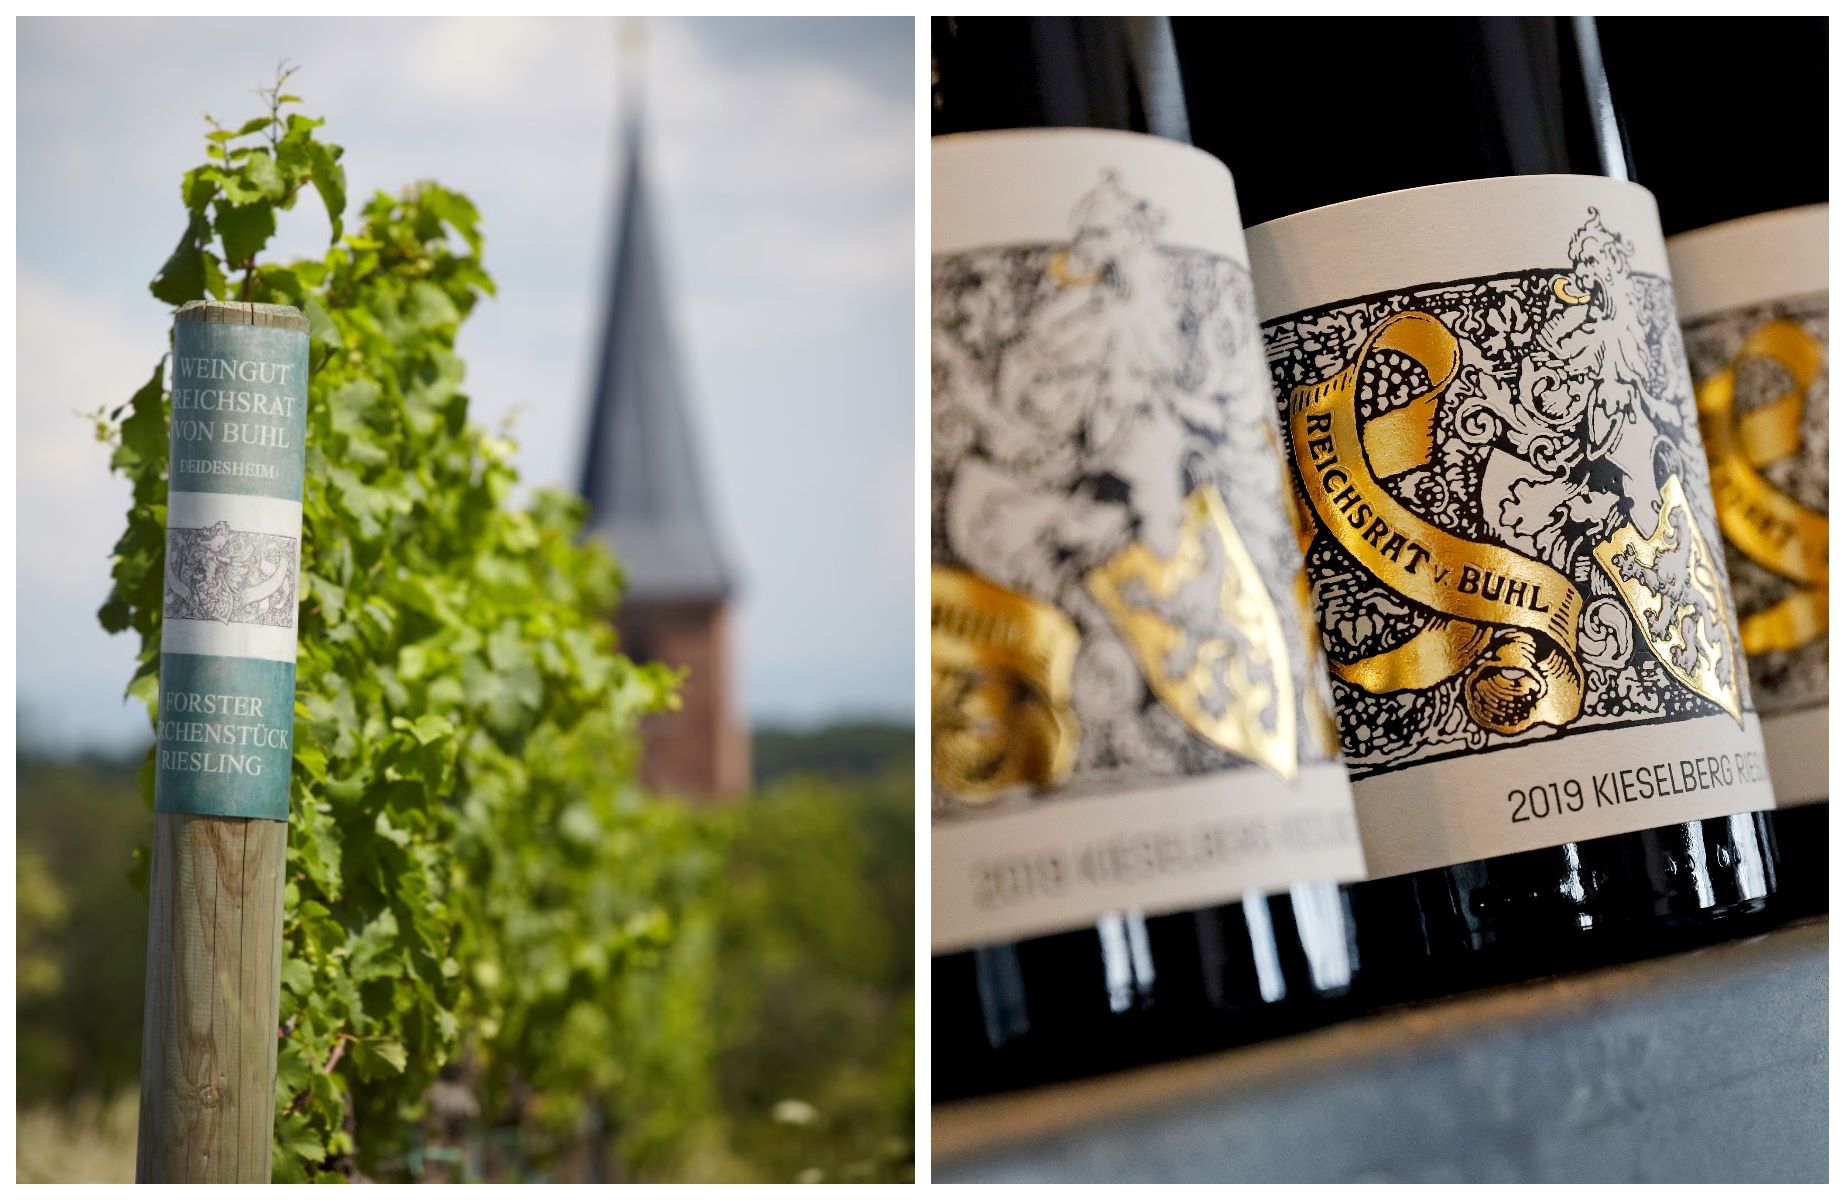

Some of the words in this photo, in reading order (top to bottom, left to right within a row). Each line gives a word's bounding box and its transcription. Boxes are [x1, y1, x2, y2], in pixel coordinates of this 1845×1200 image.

[180, 357, 292, 385] WEINGUT
[173, 388, 296, 417] REICHSRAT
[174, 420, 216, 441] VON
[221, 422, 290, 448] BUHL
[180, 459, 276, 479] DEIDESHEIM
[1306, 412, 1431, 574] REICHSRAT
[1458, 565, 1551, 613] BUHL
[166, 691, 264, 717] FORSTER
[161, 750, 262, 776] RIESLING
[1507, 778, 1585, 823] 2019
[1592, 754, 1734, 808] KIESELBERG
